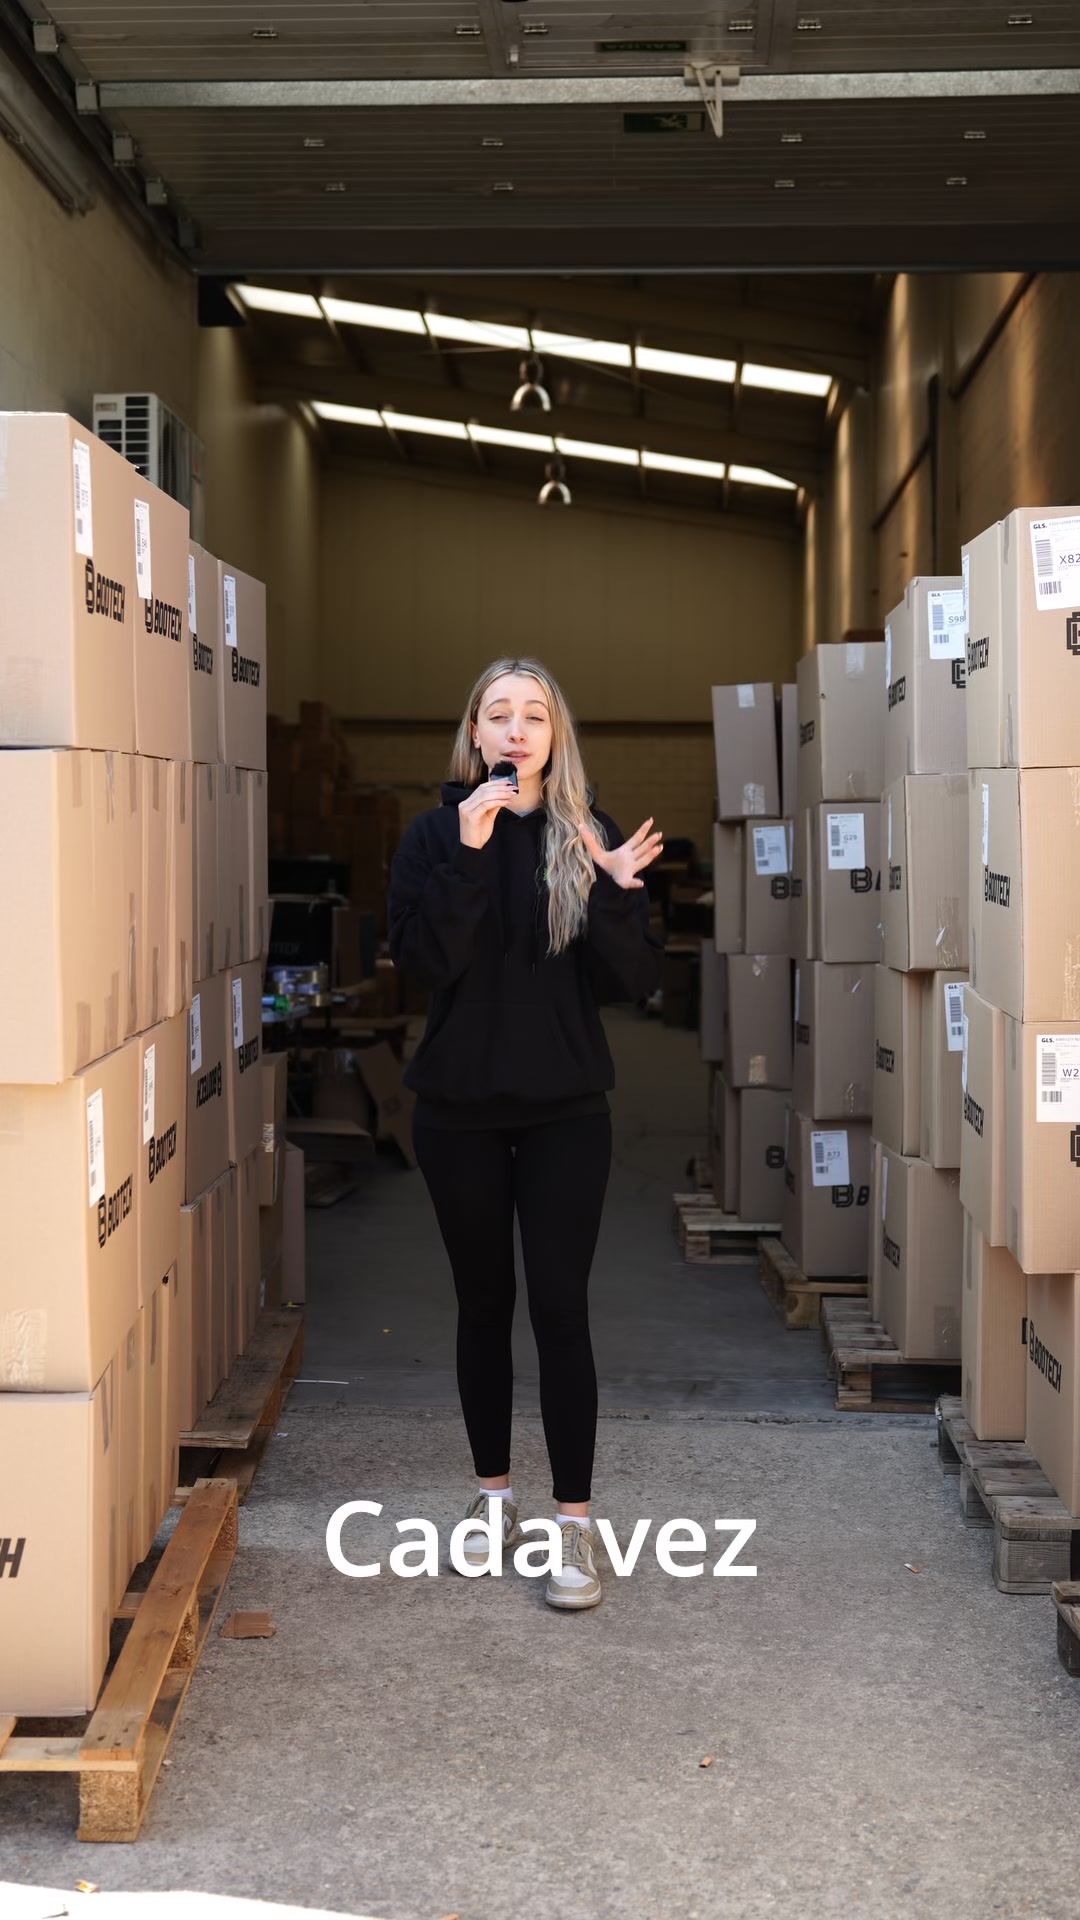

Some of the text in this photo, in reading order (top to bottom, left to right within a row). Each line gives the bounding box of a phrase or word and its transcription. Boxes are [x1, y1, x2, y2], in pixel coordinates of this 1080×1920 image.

[96, 572, 126, 624] BOOTECH
[154, 599, 182, 642] BOOTECH
[1034, 1335, 1062, 1394] BOOTECH
